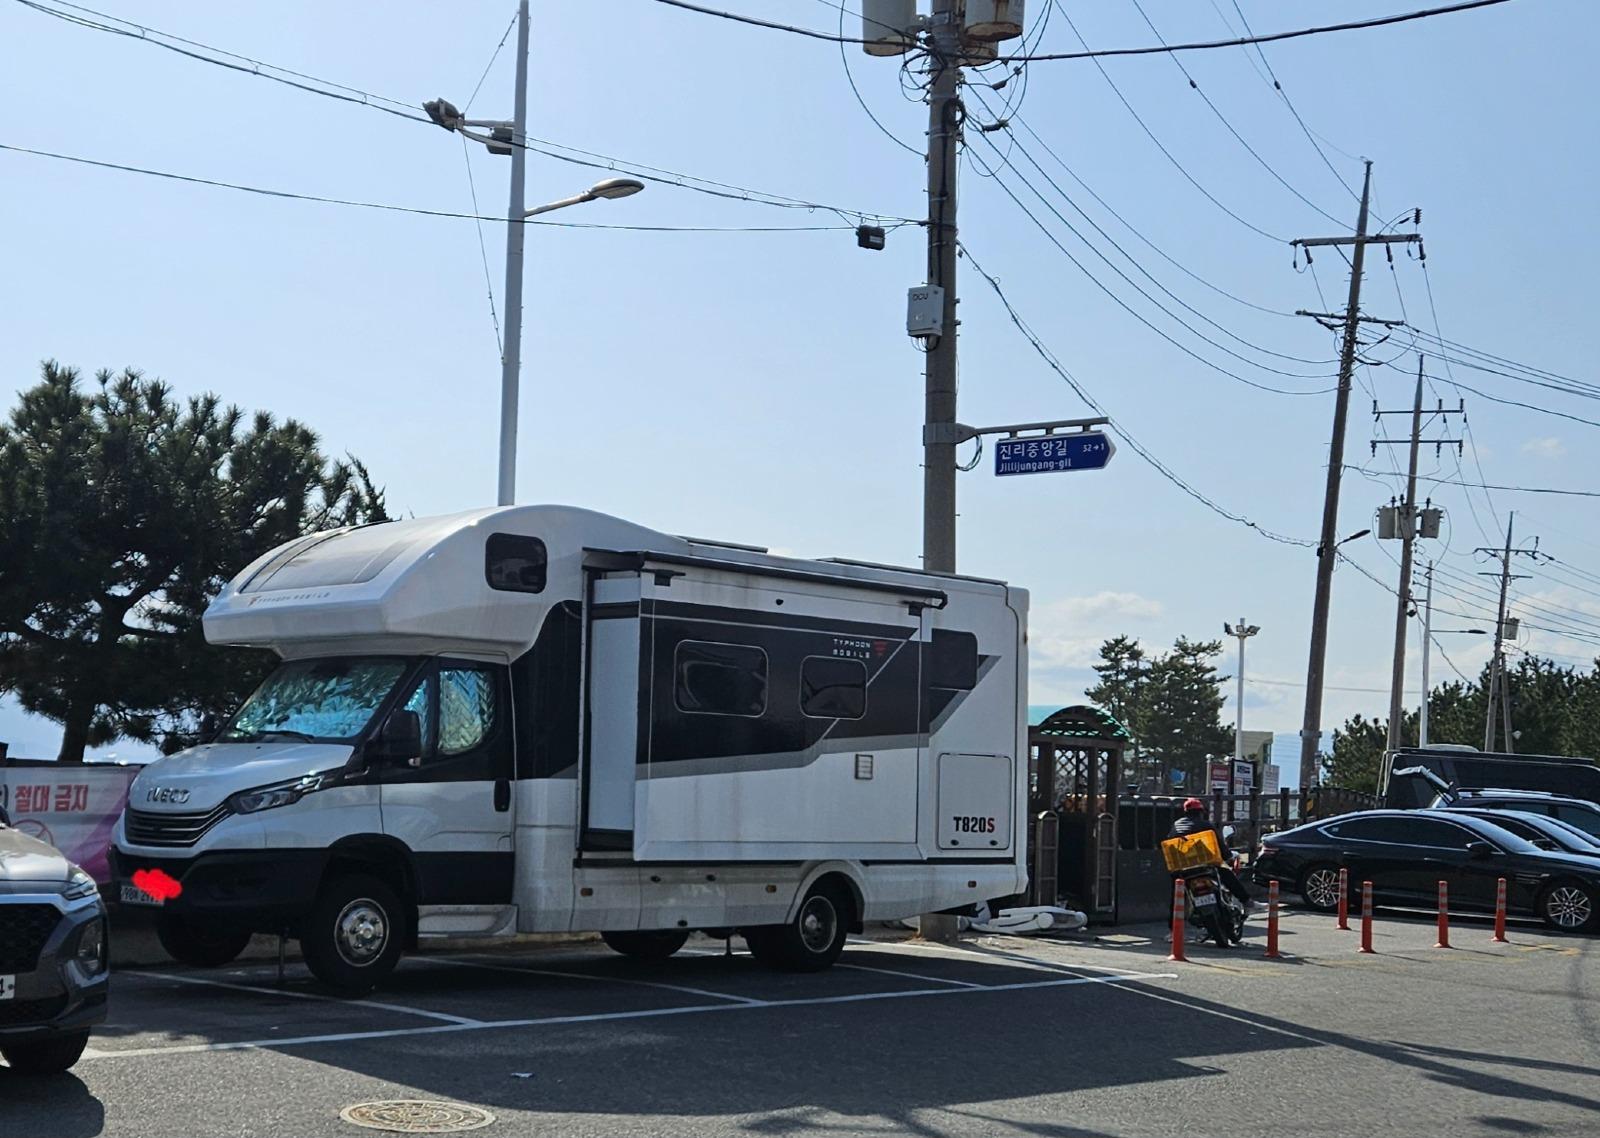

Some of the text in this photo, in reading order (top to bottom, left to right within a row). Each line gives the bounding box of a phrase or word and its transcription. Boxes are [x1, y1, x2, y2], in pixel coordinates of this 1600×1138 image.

[1000, 440, 1067, 460] 진리중앙길
[833, 638, 871, 648] TYPHOON
[15, 784, 51, 813] 절대
[54, 784, 89, 812] 금지
[953, 816, 995, 833] T820S
